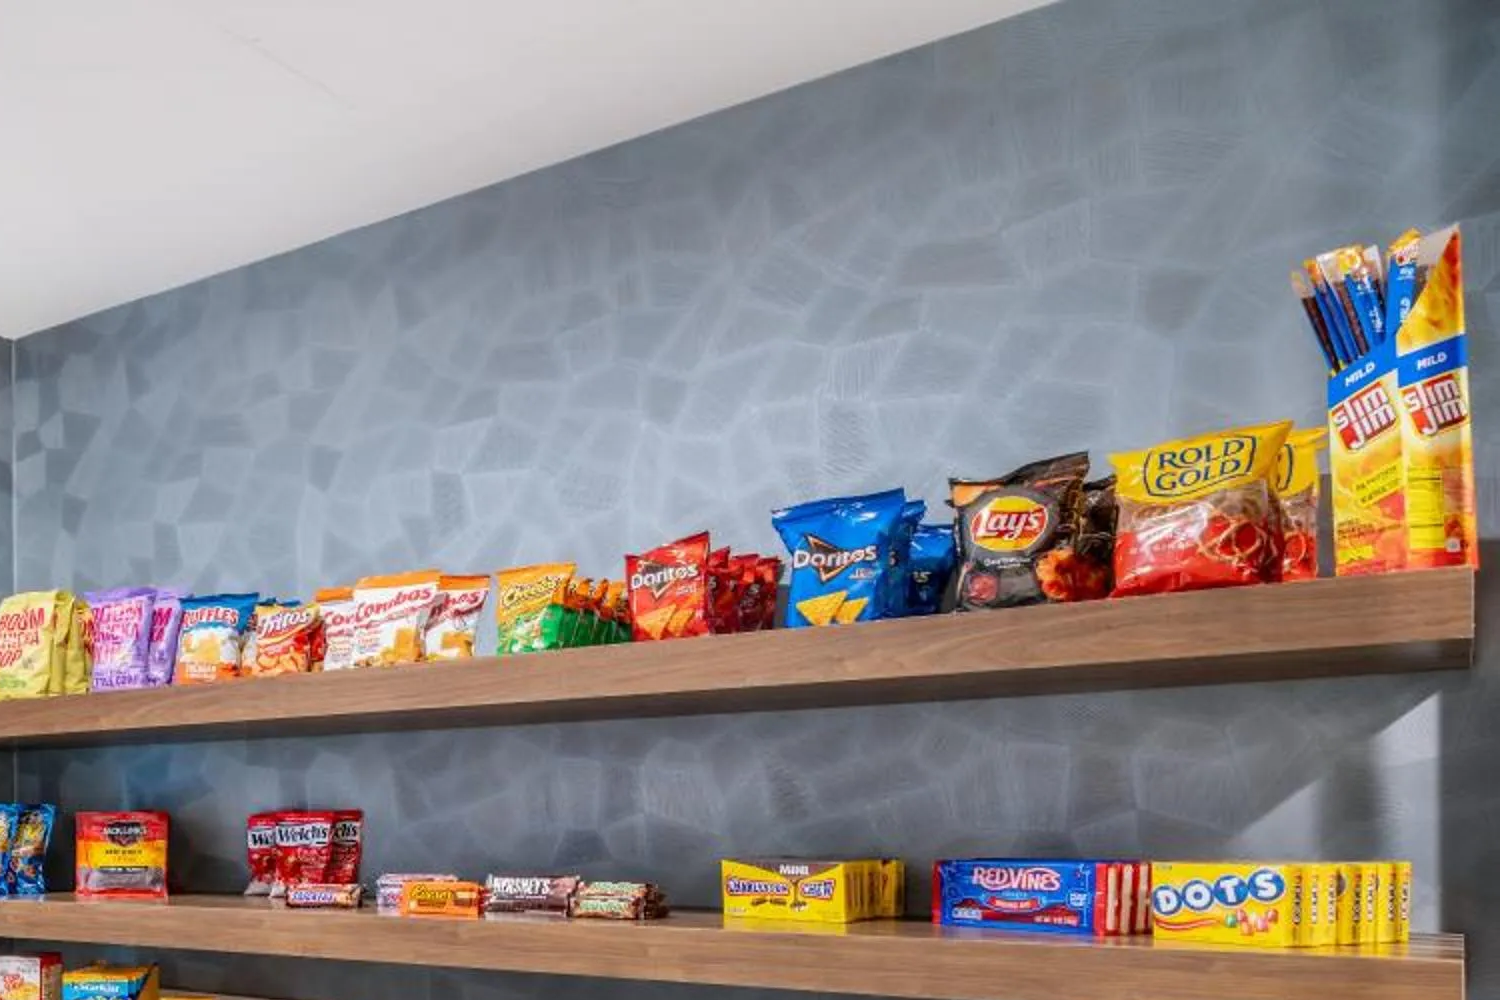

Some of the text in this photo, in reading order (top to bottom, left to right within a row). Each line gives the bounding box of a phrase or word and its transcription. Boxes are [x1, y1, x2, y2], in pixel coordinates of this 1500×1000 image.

[1345, 361, 1376, 387] MILD
[1417, 351, 1448, 371] MILD
[1158, 440, 1246, 469] ROLD
[1155, 460, 1241, 490] GOLD
[793, 546, 877, 569] Doritos
[631, 564, 699, 590] Doritos
[779, 864, 810, 876] MINI
[1155, 871, 1280, 913] DOTS
